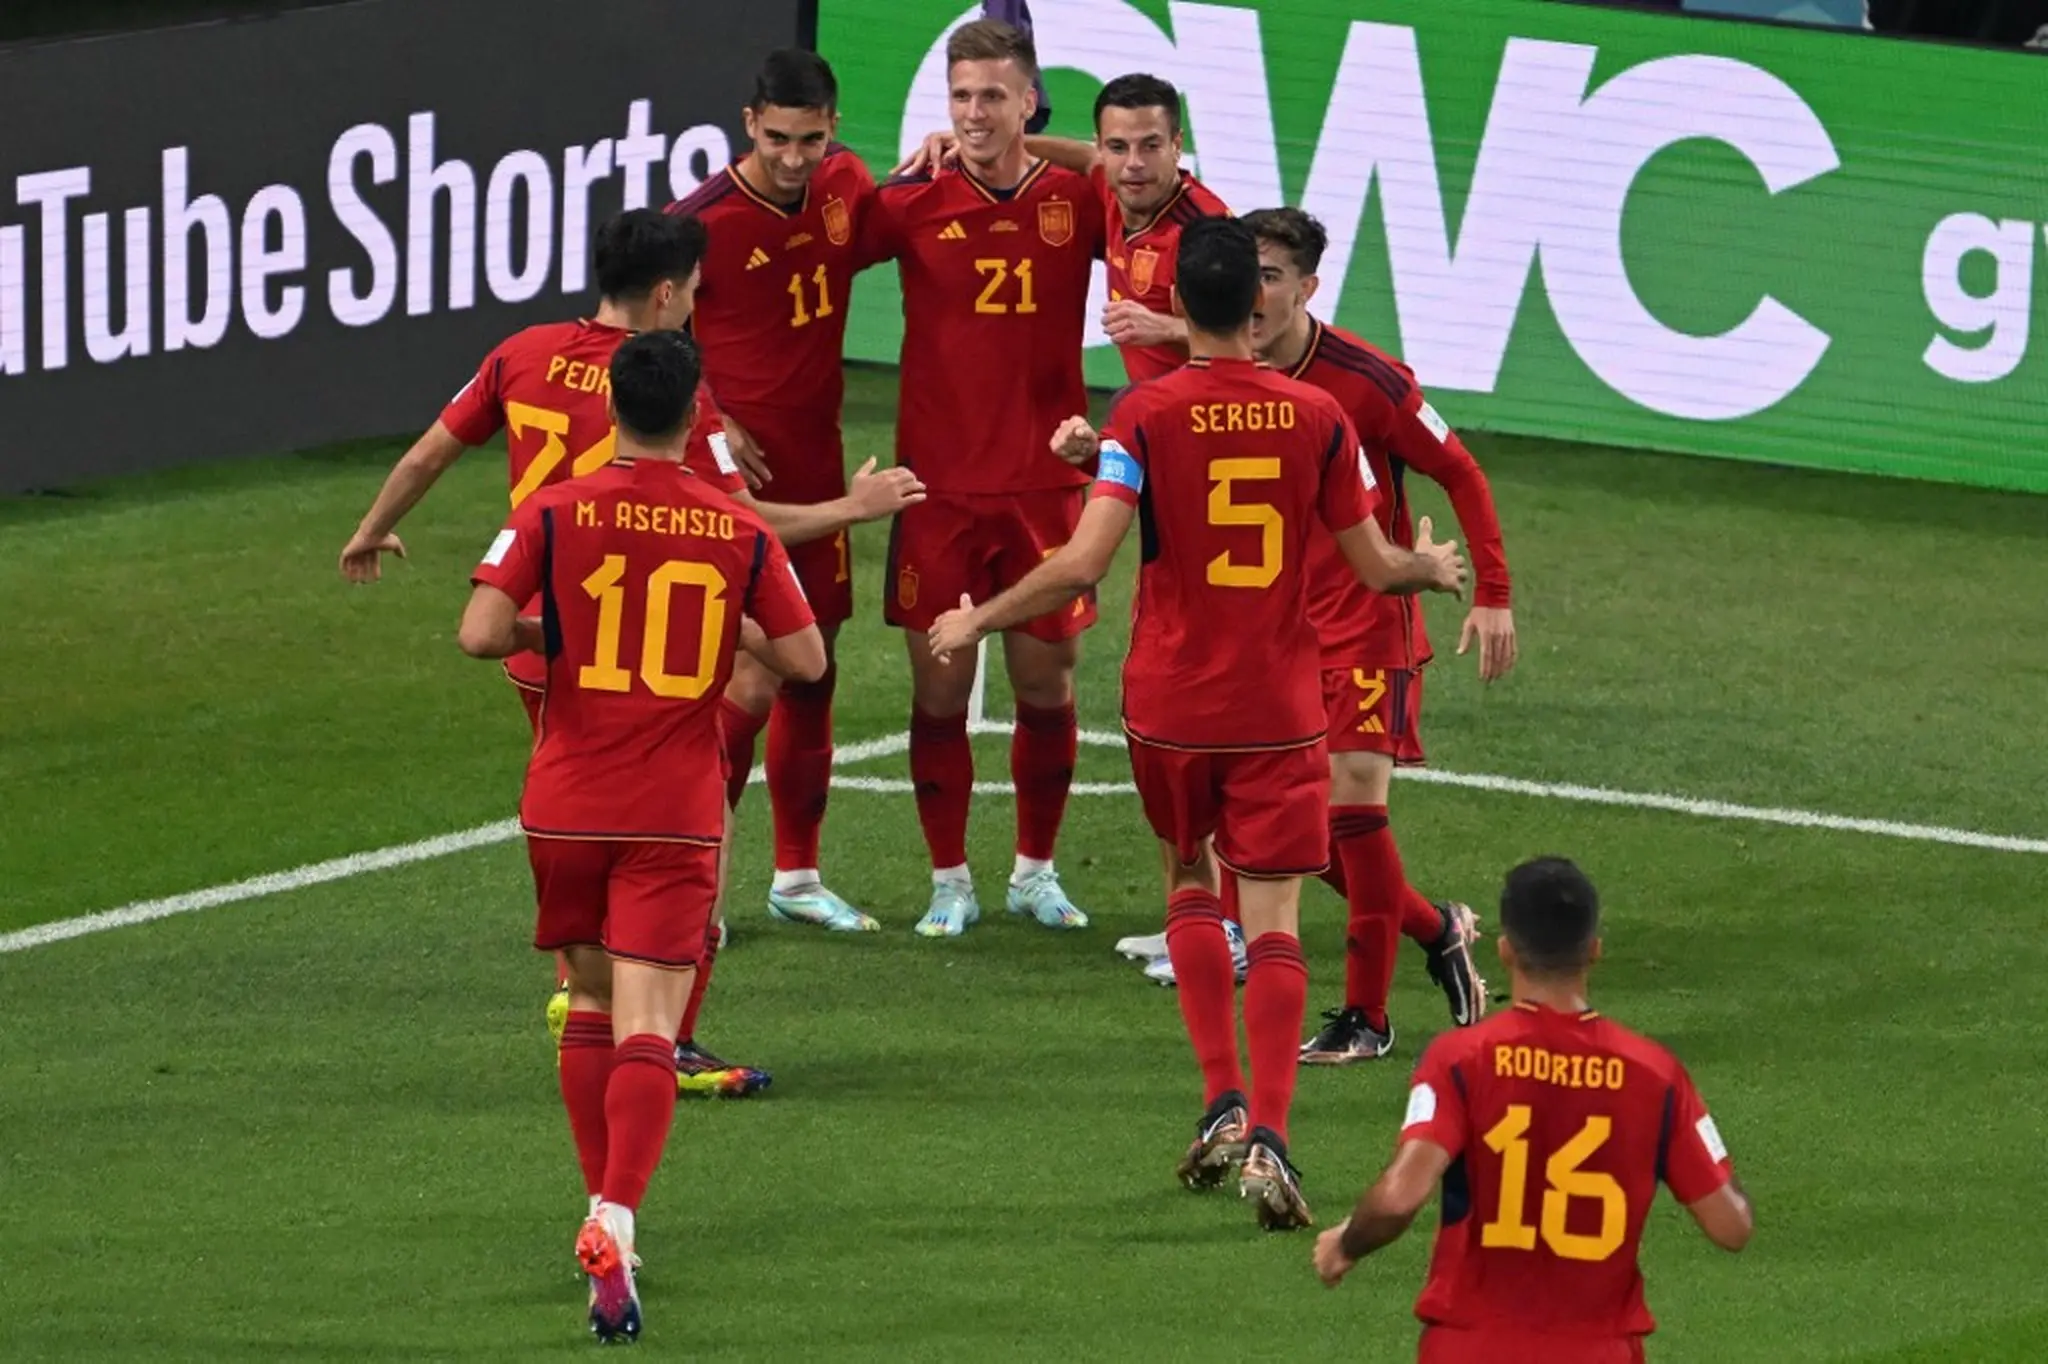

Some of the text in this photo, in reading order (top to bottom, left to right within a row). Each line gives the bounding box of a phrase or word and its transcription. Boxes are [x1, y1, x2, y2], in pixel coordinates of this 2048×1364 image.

[787, 263, 833, 327] 11
[974, 257, 1037, 313] 21
[1922, 212, 2048, 382] g
[1190, 401, 1296, 433] SERGIO
[576, 500, 736, 540] M. ASENSIO
[1207, 457, 1284, 588] 5
[578, 554, 728, 700] 10
[1495, 1045, 1625, 1090] RODRIGO
[1481, 1105, 1628, 1261] 16
